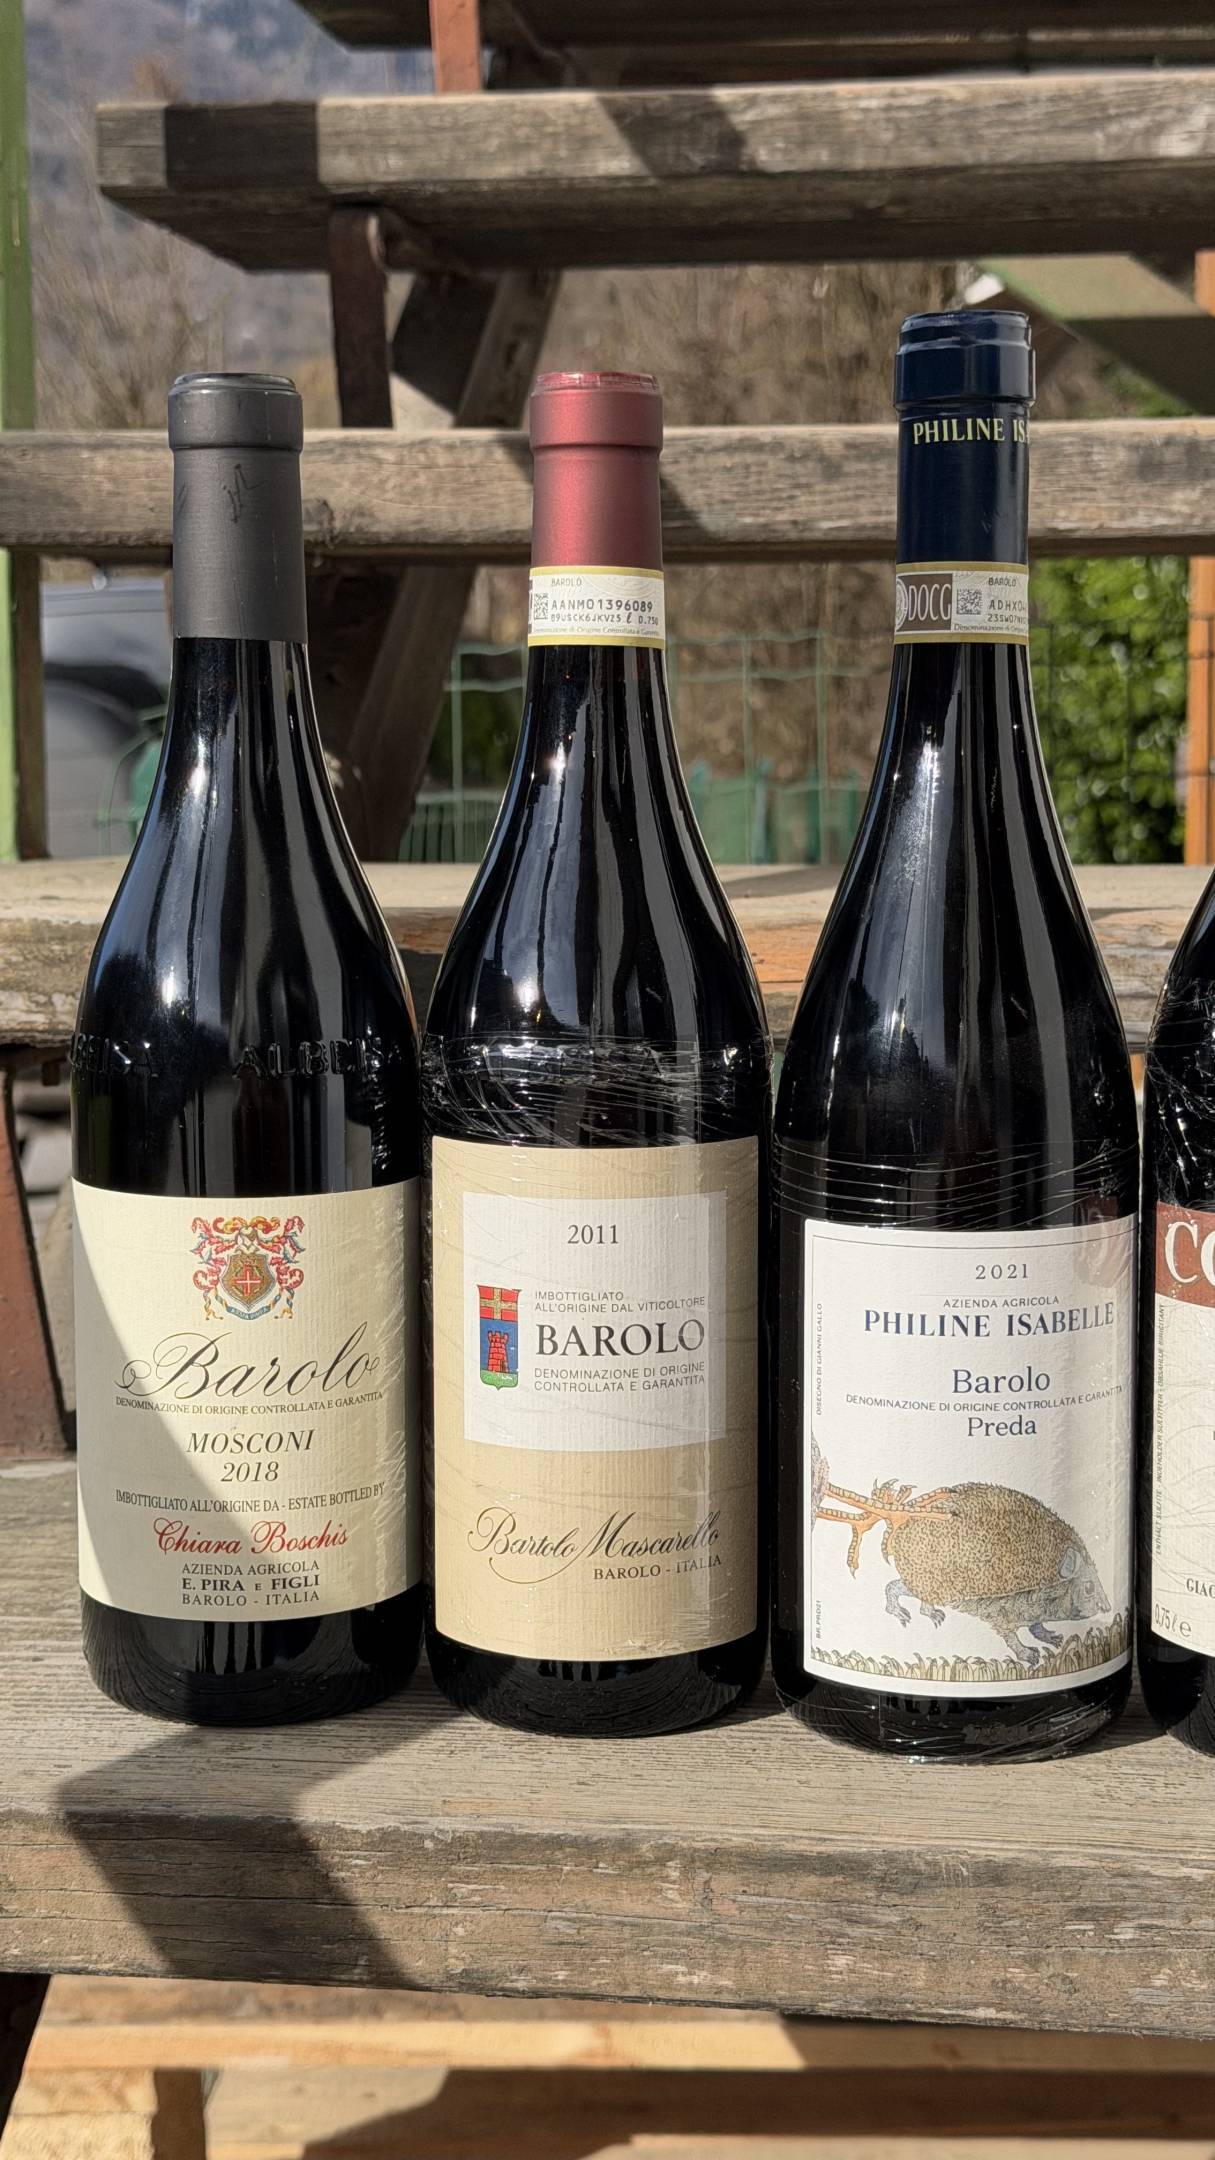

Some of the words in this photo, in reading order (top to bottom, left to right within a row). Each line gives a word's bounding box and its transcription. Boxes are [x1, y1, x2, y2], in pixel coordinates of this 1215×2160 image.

[913, 417, 1005, 445] PHILINE
[1013, 419, 1030, 444] IS
[908, 583, 951, 620] DOCG
[567, 1224, 619, 1245] 2011
[975, 1264, 1029, 1280] 2021
[534, 1302, 608, 1314] ALL'ORIGINE
[611, 1302, 633, 1313] DAL
[637, 1296, 705, 1313] VITICOLTORE
[535, 1291, 624, 1302] IMBOTTIGLIATO
[943, 1298, 998, 1309] AZIENDA
[1002, 1296, 1059, 1308] AGRICOLA
[864, 1309, 990, 1338] PHILINE
[1006, 1301, 1114, 1336] ISABELLE
[536, 1319, 705, 1357] BAROLO
[115, 1321, 380, 1399] Barolo
[534, 1367, 639, 1380] DENOMINAZIONE
[643, 1367, 655, 1378] DI
[659, 1361, 705, 1376] ORIGINE
[816, 1367, 823, 1376] DI
[952, 1366, 1050, 1394] Barolo
[534, 1381, 624, 1393] CONTROLLATA
[629, 1381, 637, 1392] E
[642, 1374, 705, 1391] GARANTITA
[115, 1396, 190, 1415] DENOMINAZIONE
[192, 1404, 203, 1415] DI
[205, 1404, 248, 1415] ORIGINE
[251, 1402, 326, 1415] CONTROLLATA
[328, 1399, 333, 1409] E
[846, 1394, 936, 1412] DENOMINAZIONE
[939, 1403, 950, 1412] DI
[953, 1402, 1000, 1412] ORIGINE
[1003, 1397, 1076, 1412] CONTROLLATA
[1078, 1396, 1083, 1404] E
[968, 1415, 1037, 1436] Preda
[187, 1429, 315, 1455] MOSCONI
[220, 1461, 279, 1483] 2018
[116, 1489, 188, 1512] IMBOTTIGLIATO
[189, 1499, 261, 1514] ALL'ORIGINE
[263, 1500, 279, 1512] DA
[288, 1496, 328, 1511] ESTATE
[329, 1486, 373, 1507] BOTTLED
[374, 1482, 386, 1497] BY
[153, 1517, 242, 1556] Chiara
[250, 1519, 349, 1555] Boschis
[467, 1506, 579, 1559] Bartolo
[579, 1509, 721, 1560] Mascarello
[182, 1563, 246, 1576] AZIENDA
[247, 1560, 320, 1575] AGRICOLA
[594, 1565, 661, 1581] BAROLO
[675, 1554, 722, 1574] ITALIA
[182, 1578, 197, 1592] E.
[200, 1578, 245, 1592] PIRA
[271, 1574, 321, 1590] FIGLI
[182, 1593, 247, 1607] BAROLO
[265, 1591, 320, 1605] ITALIA
